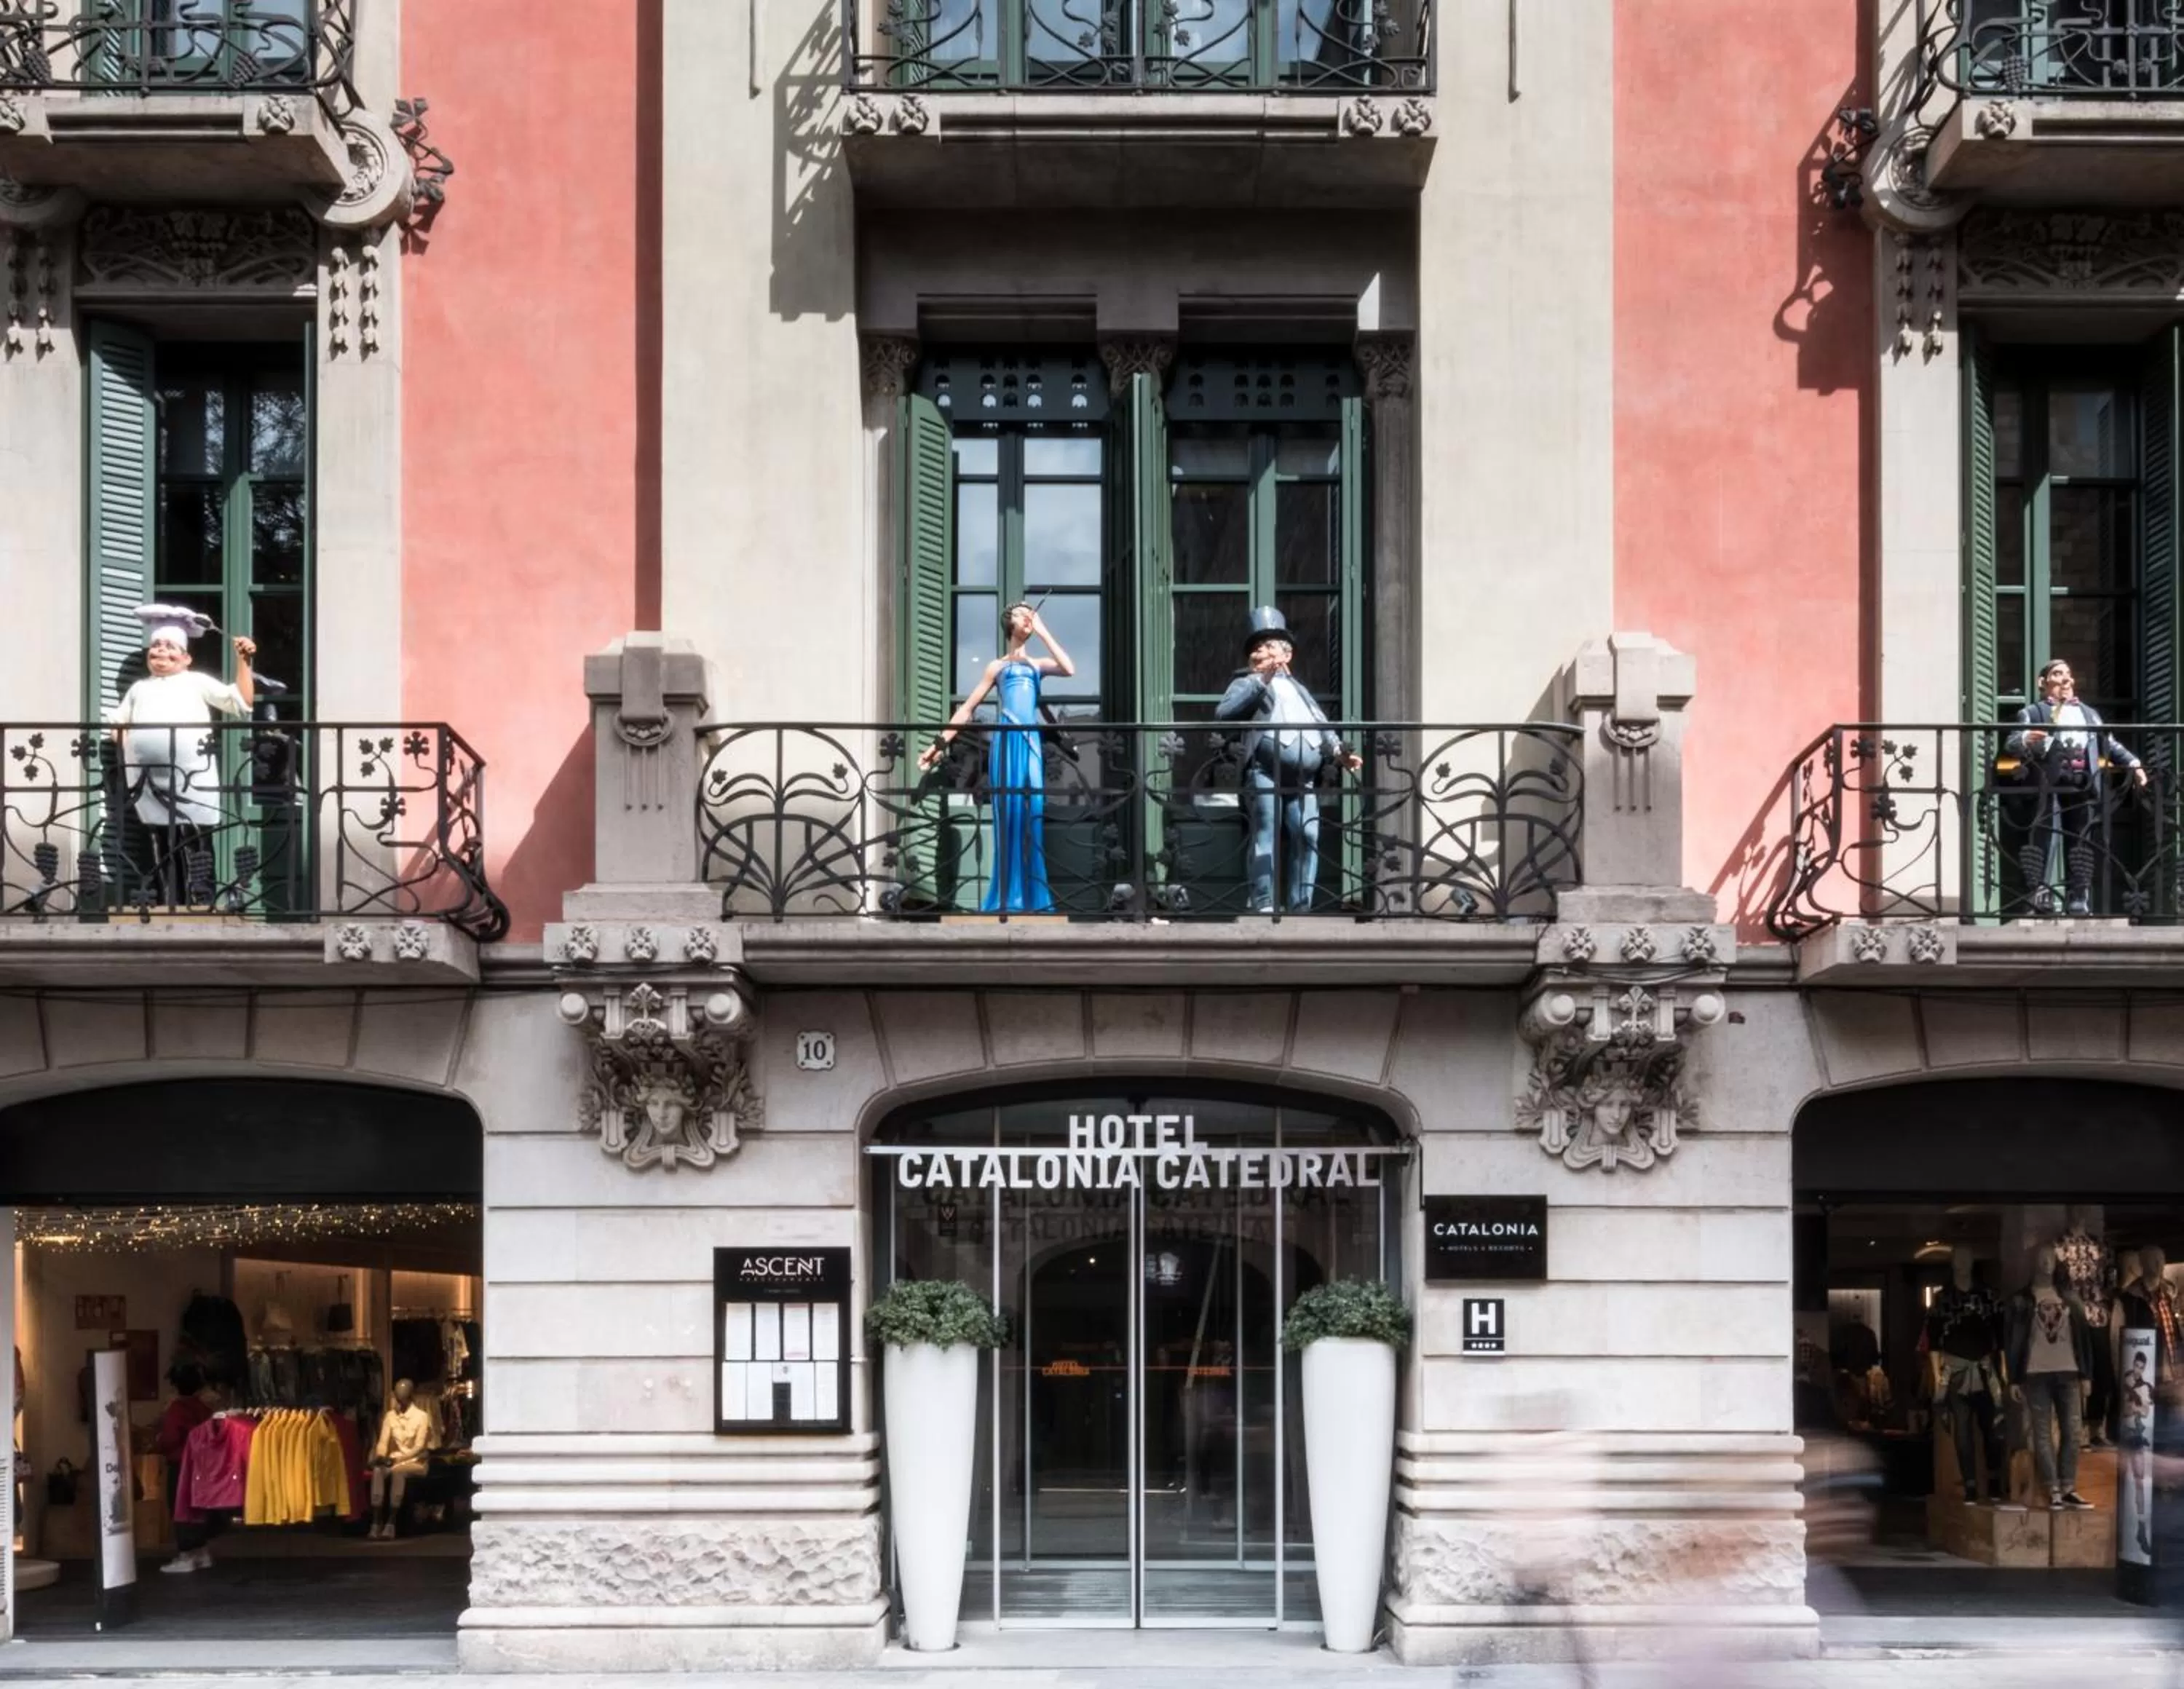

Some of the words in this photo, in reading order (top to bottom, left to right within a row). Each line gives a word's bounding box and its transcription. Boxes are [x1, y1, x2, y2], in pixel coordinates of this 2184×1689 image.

[803, 1040, 826, 1061] 10
[1068, 1114, 1208, 1150] HOTEL
[898, 1150, 1141, 1189] CATALONIA
[1155, 1150, 1380, 1189] CATEDRAL
[1433, 1222, 1538, 1235] CATALONIA
[740, 1257, 825, 1276] ASCENT
[1471, 1302, 1496, 1334] H
